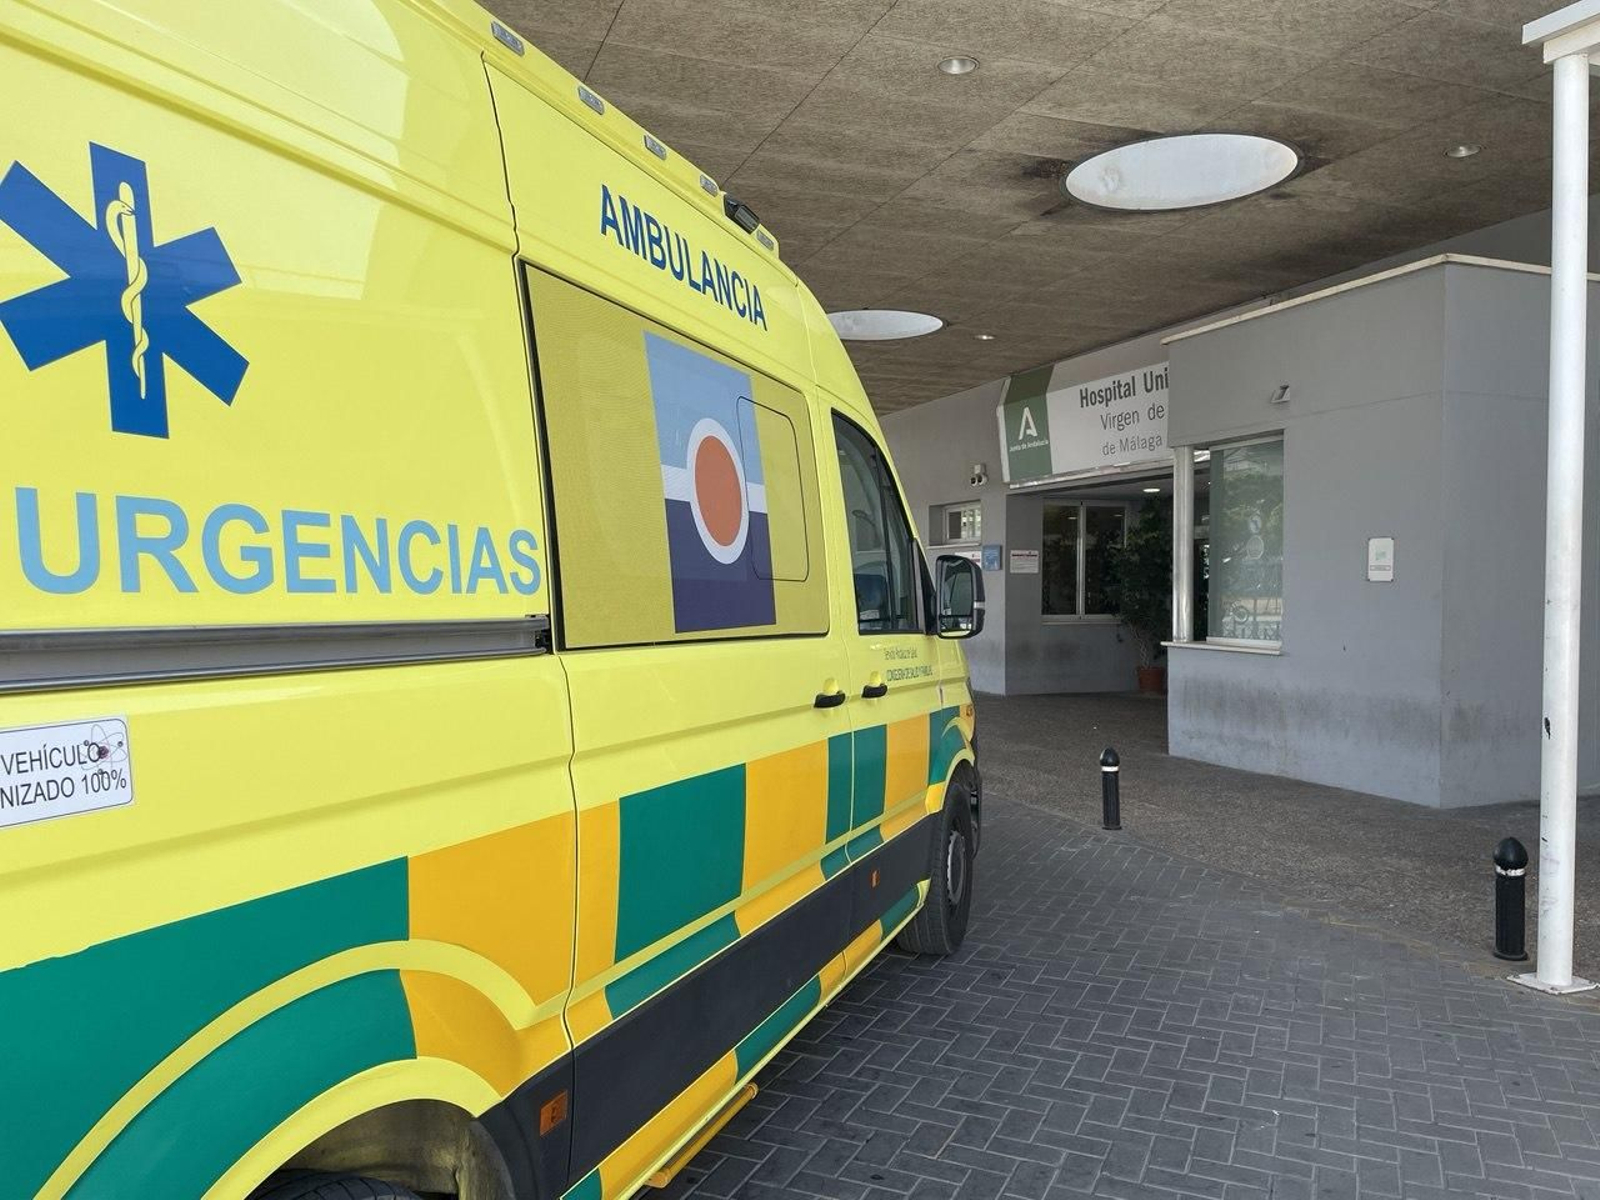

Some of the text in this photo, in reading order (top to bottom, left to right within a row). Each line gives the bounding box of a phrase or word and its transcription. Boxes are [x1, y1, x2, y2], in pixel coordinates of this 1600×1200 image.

[600, 184, 768, 331] AMBULANCIA
[1079, 366, 1169, 408] Hospital Uni
[1100, 402, 1165, 431] Virgen de
[1102, 433, 1163, 456] de Málaga
[15, 487, 541, 595] URGENCIAS
[0, 742, 101, 776] VEHÍCULO
[0, 768, 127, 809] NIZADO 100%
